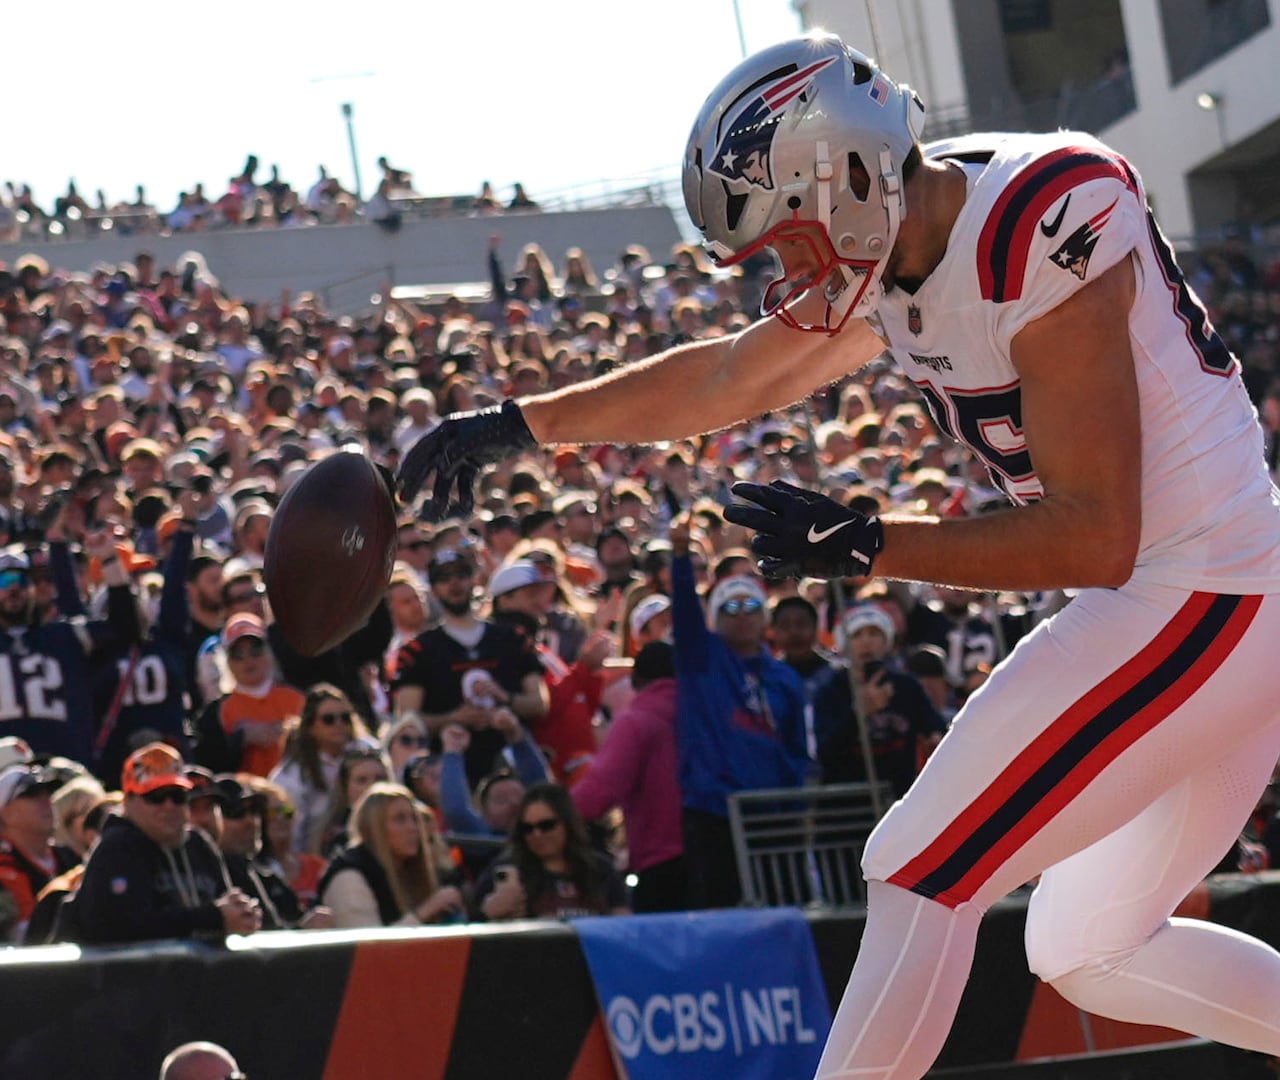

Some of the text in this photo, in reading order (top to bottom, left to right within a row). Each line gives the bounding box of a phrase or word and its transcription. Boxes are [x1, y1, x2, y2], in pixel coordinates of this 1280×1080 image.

[116, 654, 168, 707] 10
[643, 986, 817, 1056] CBS NFL
